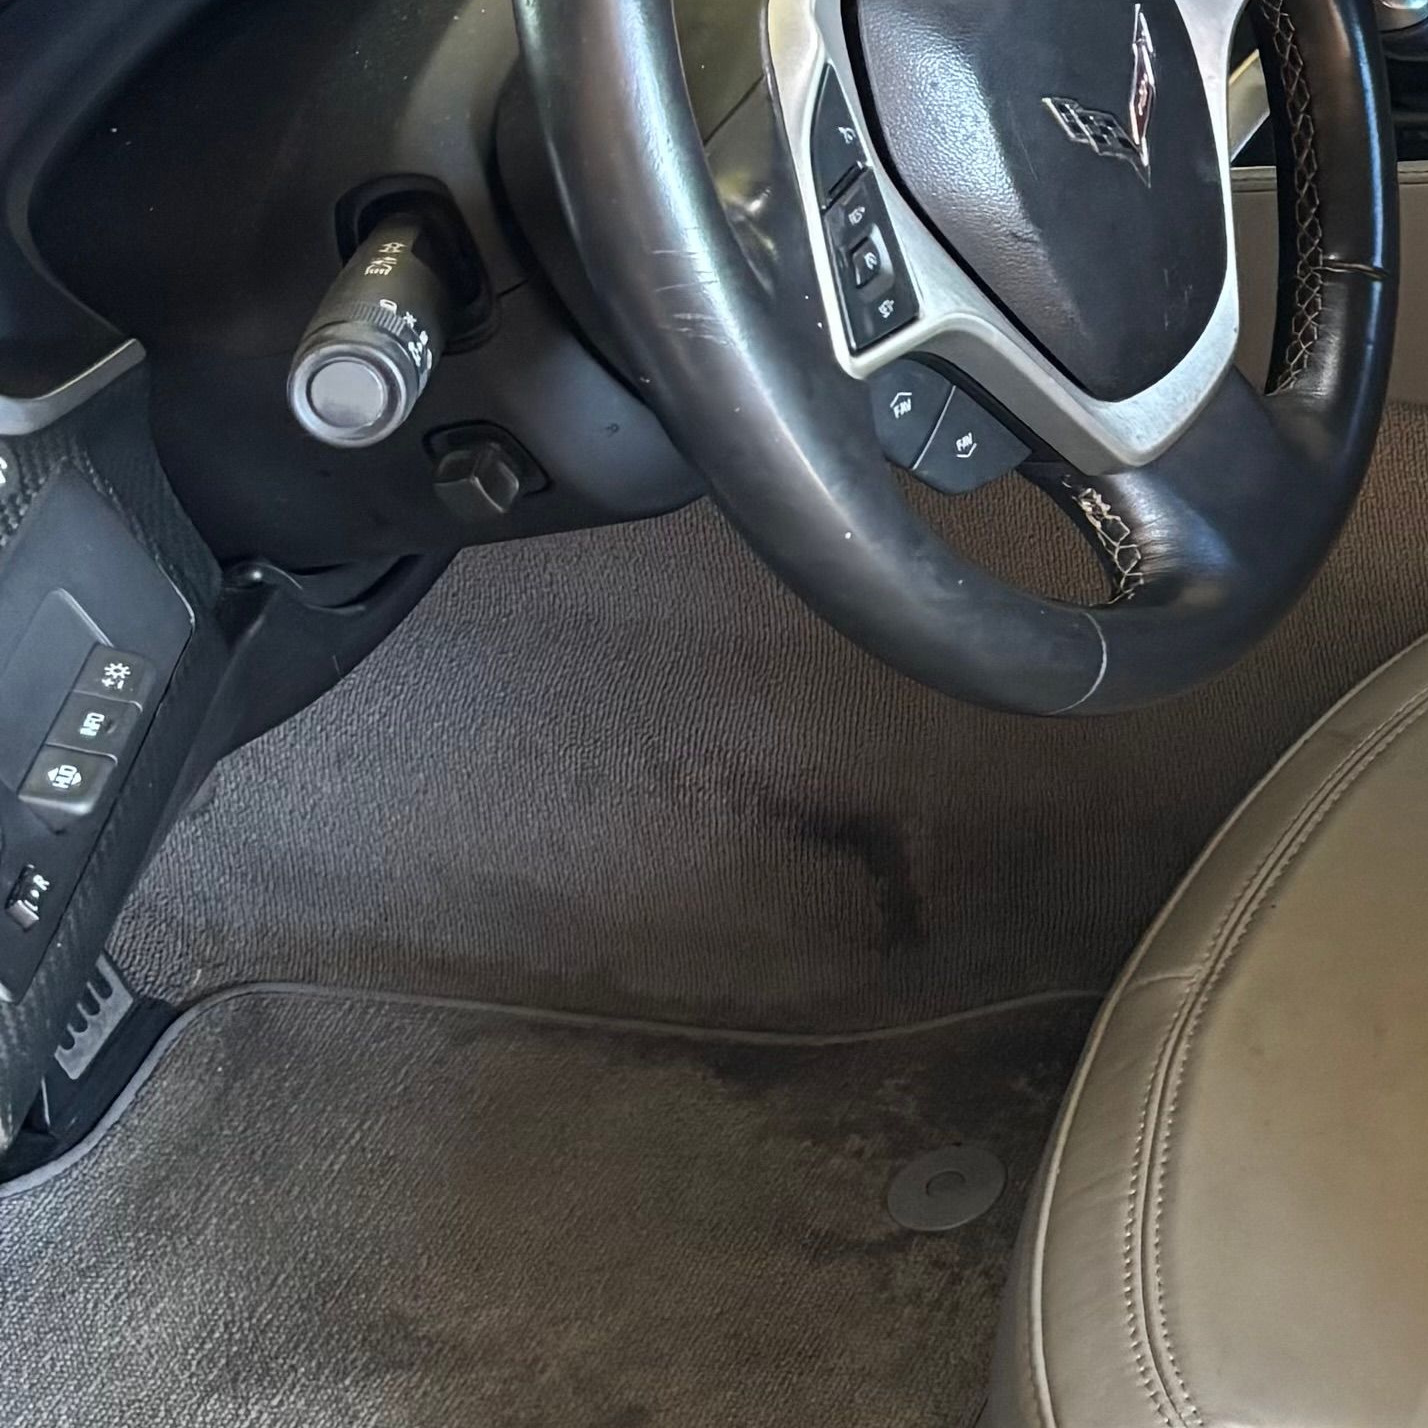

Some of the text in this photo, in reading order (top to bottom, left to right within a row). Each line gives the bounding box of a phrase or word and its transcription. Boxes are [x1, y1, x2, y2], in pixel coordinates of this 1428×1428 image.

[893, 398, 912, 419] FAV
[956, 432, 972, 452] FAV
[80, 712, 105, 737] INFO
[52, 764, 78, 789] HUD
[33, 874, 50, 891] R
